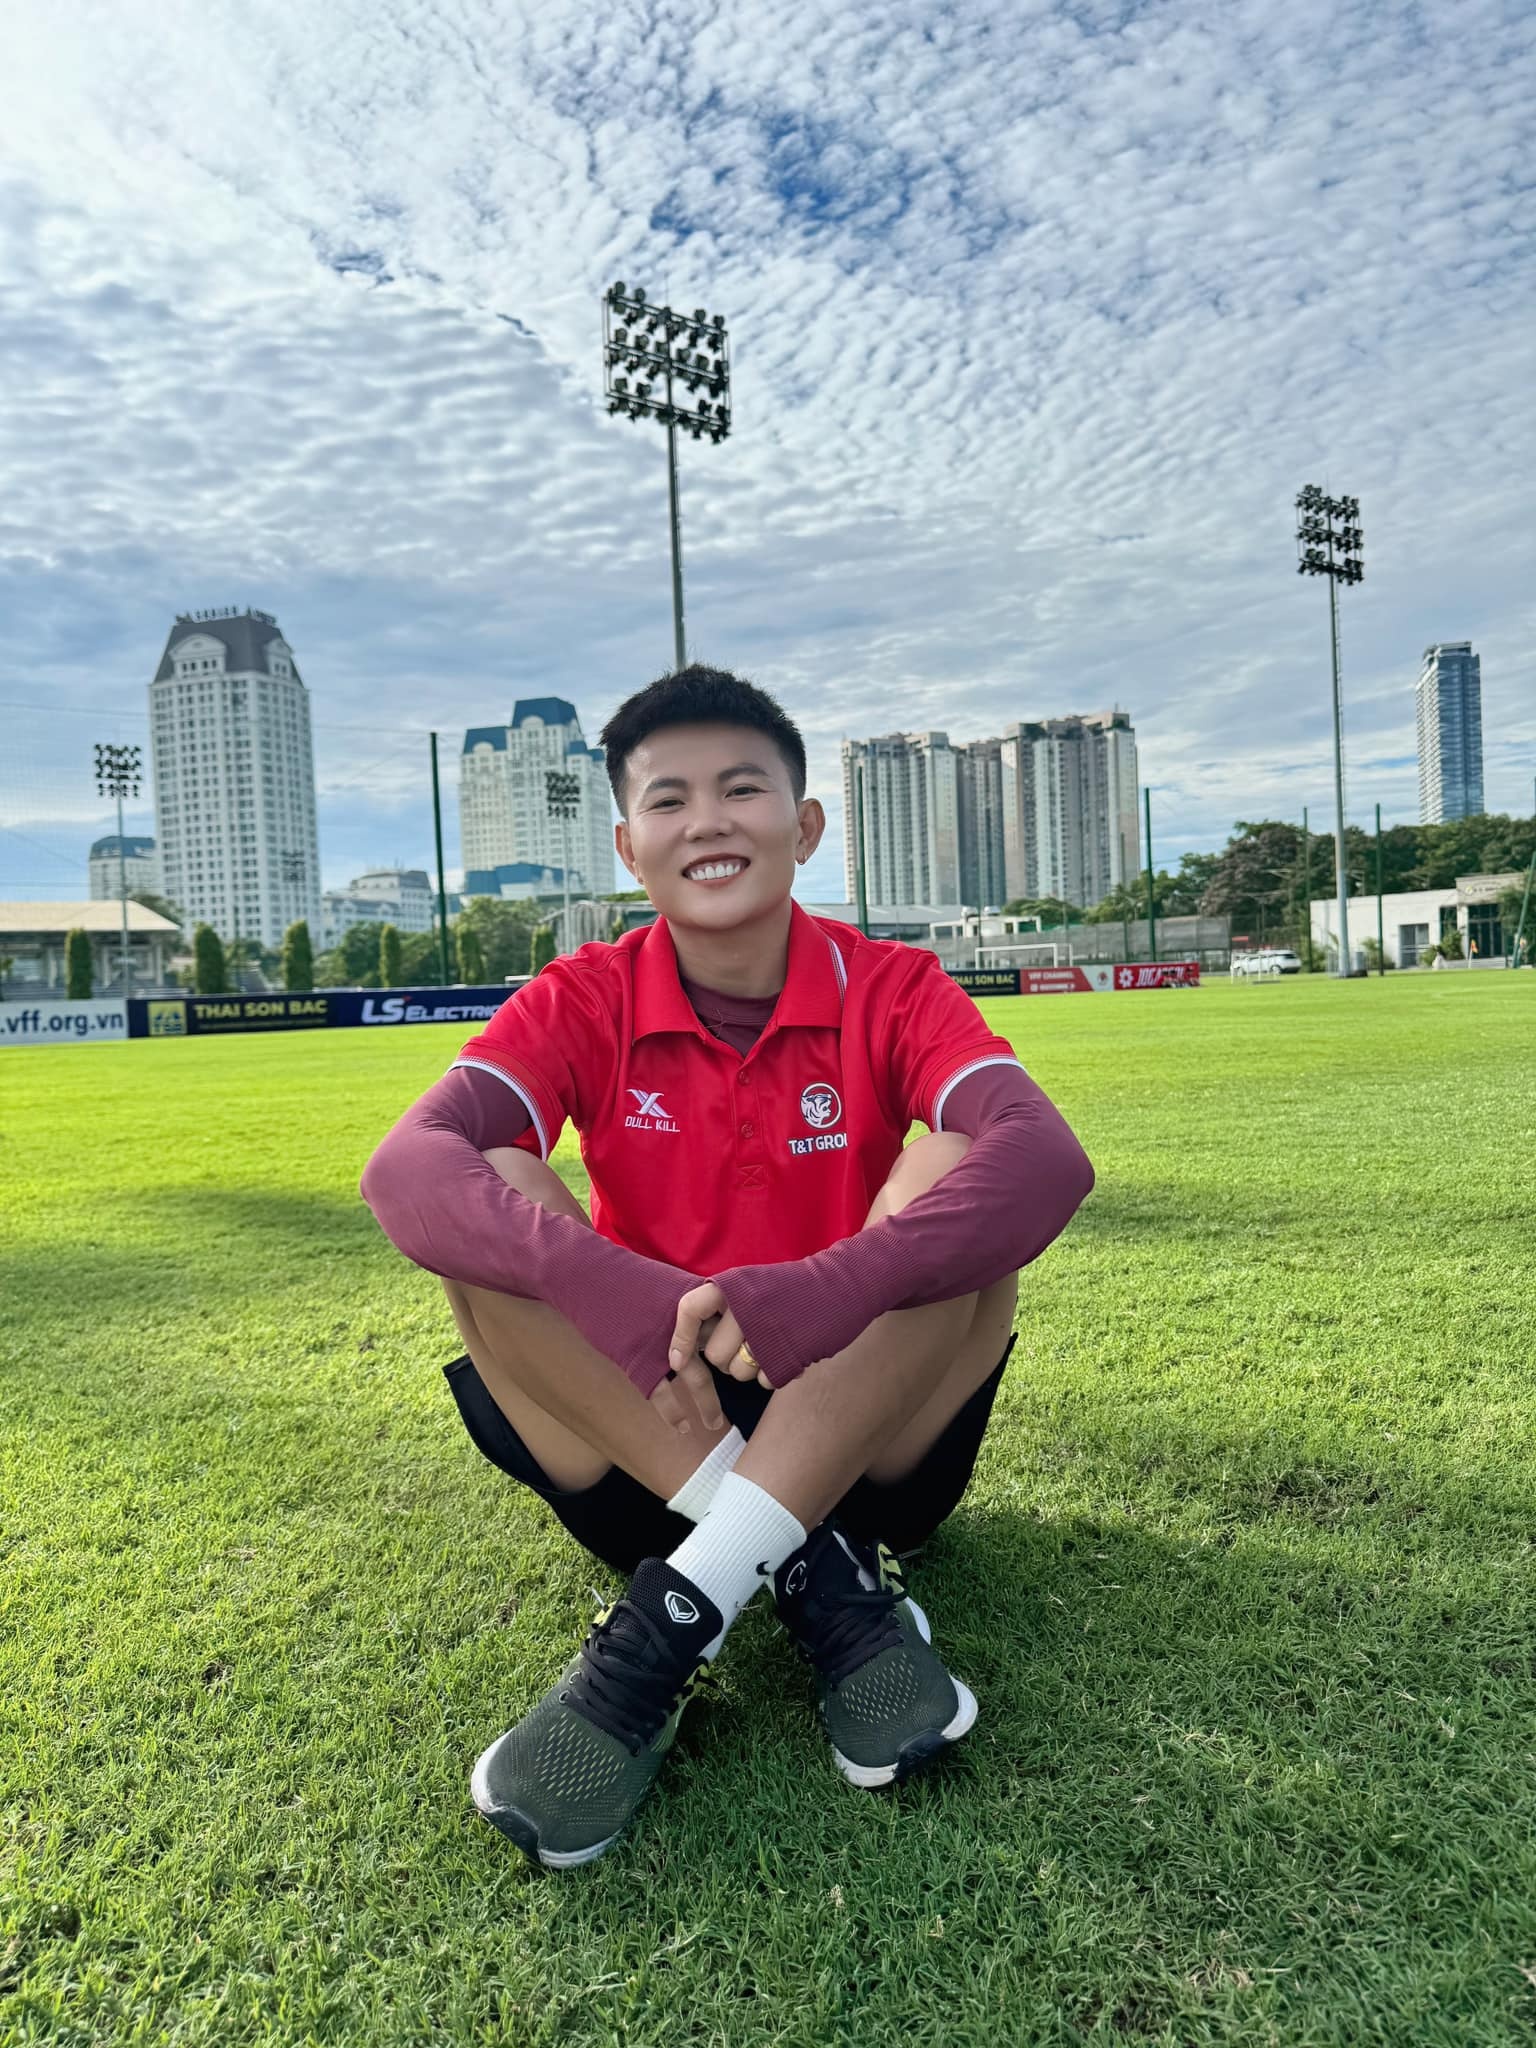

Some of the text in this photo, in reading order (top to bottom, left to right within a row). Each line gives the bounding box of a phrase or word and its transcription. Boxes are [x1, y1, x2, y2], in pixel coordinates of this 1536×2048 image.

[194, 1000, 328, 1019] THAI SON BAC
[361, 998, 405, 1024] LS
[624, 1116, 681, 1132] DULL KILL
[788, 1132, 847, 1154] T&T GRO
